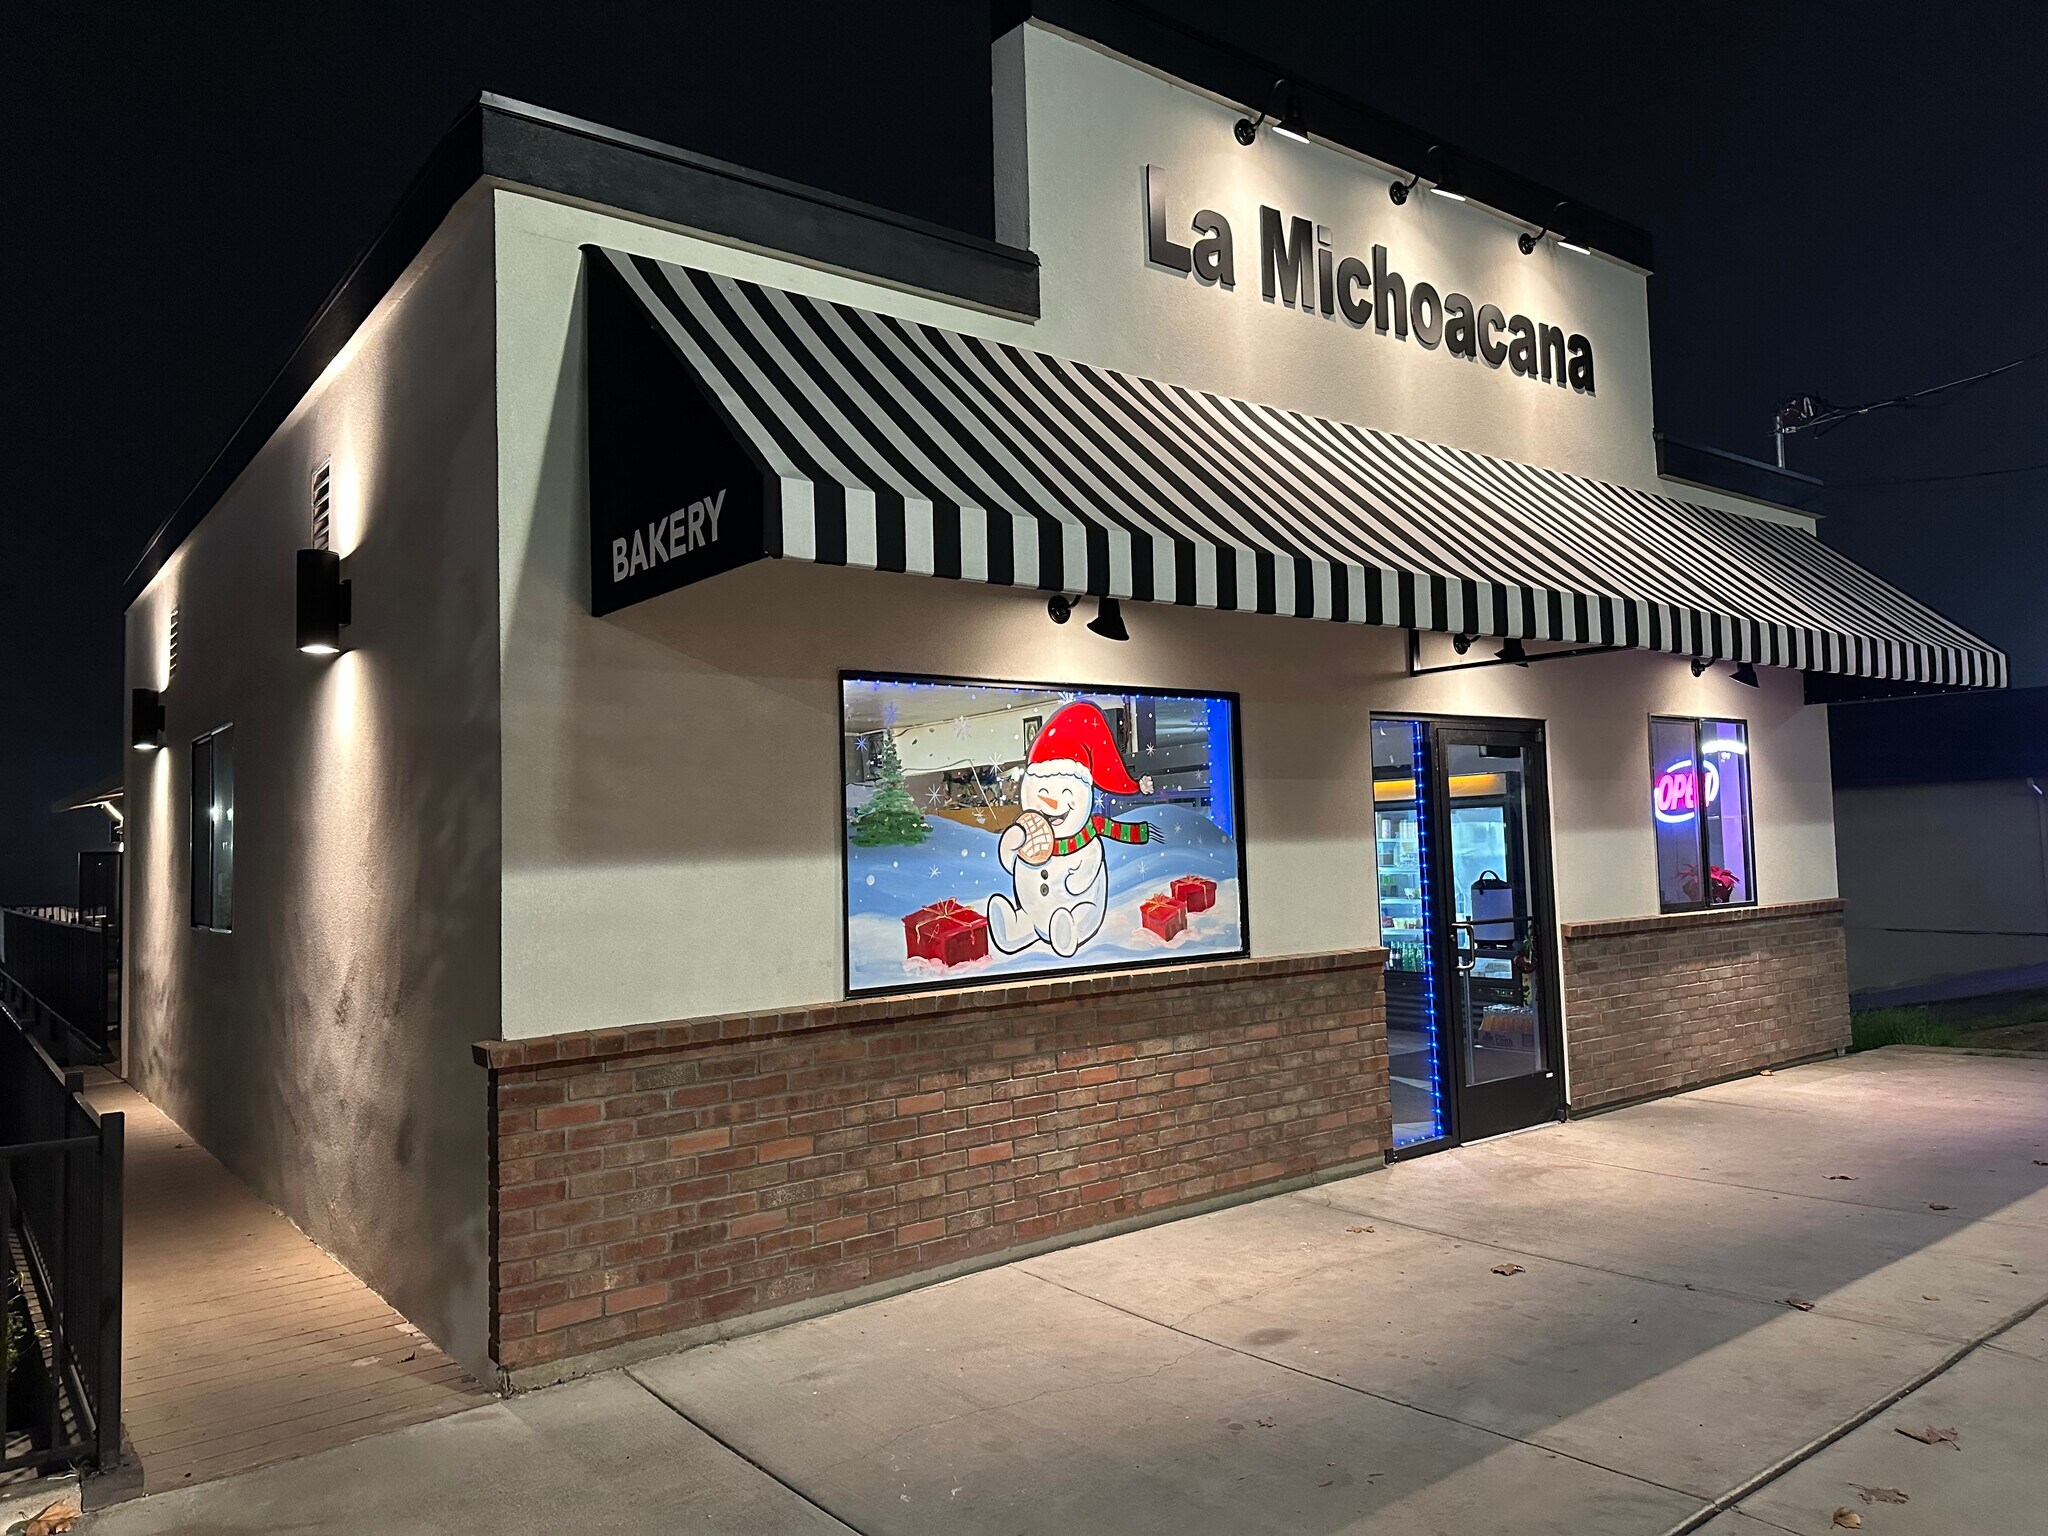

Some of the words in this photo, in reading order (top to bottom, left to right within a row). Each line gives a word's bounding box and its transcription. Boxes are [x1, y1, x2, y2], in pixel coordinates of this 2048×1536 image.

[1146, 164, 1235, 286] La
[1260, 204, 1595, 393] Michoacana
[612, 488, 727, 583] BAKERY
